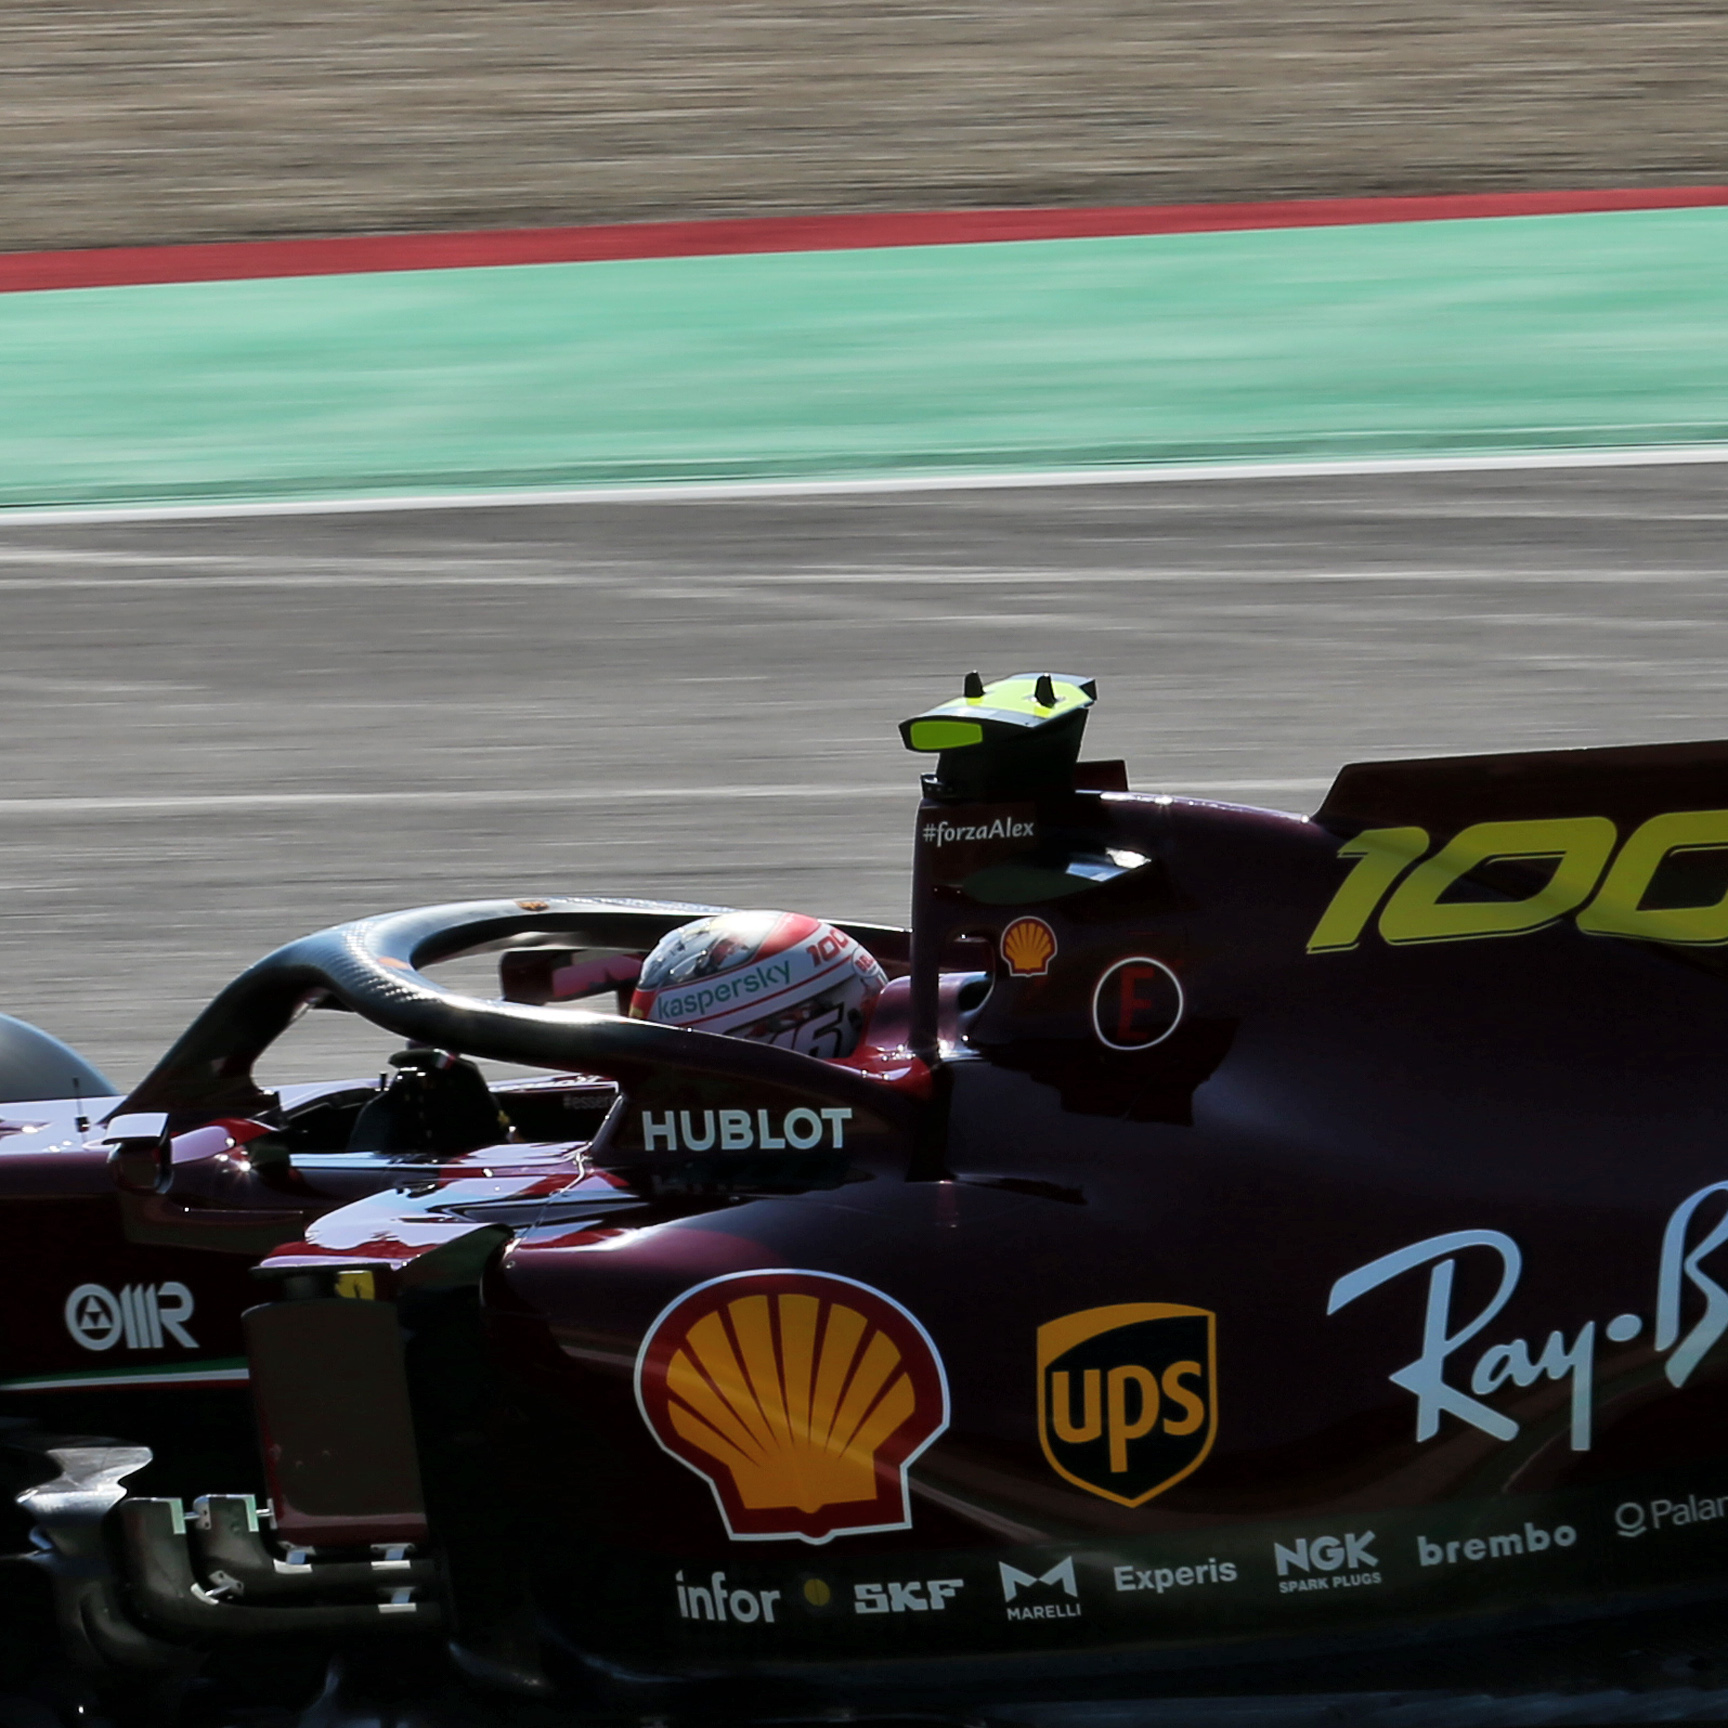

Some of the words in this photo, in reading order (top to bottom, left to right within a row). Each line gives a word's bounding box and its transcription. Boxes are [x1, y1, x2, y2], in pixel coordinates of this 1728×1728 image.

[923, 816, 1035, 848] #forzaAlex
[658, 960, 791, 1019] kaspersky
[642, 1107, 853, 1151] HUBLOT
[1052, 1360, 1205, 1474] ups
[1274, 1530, 1379, 1576] NGK
[1416, 1521, 1578, 1566] brembo
[675, 1570, 781, 1623] infor
[854, 1578, 964, 1614] SKF
[1114, 1558, 1238, 1594] Experis
[1278, 1577, 1329, 1594] SPARK
[1332, 1572, 1382, 1588] PLUGS
[1006, 1604, 1081, 1621] MARELLI
